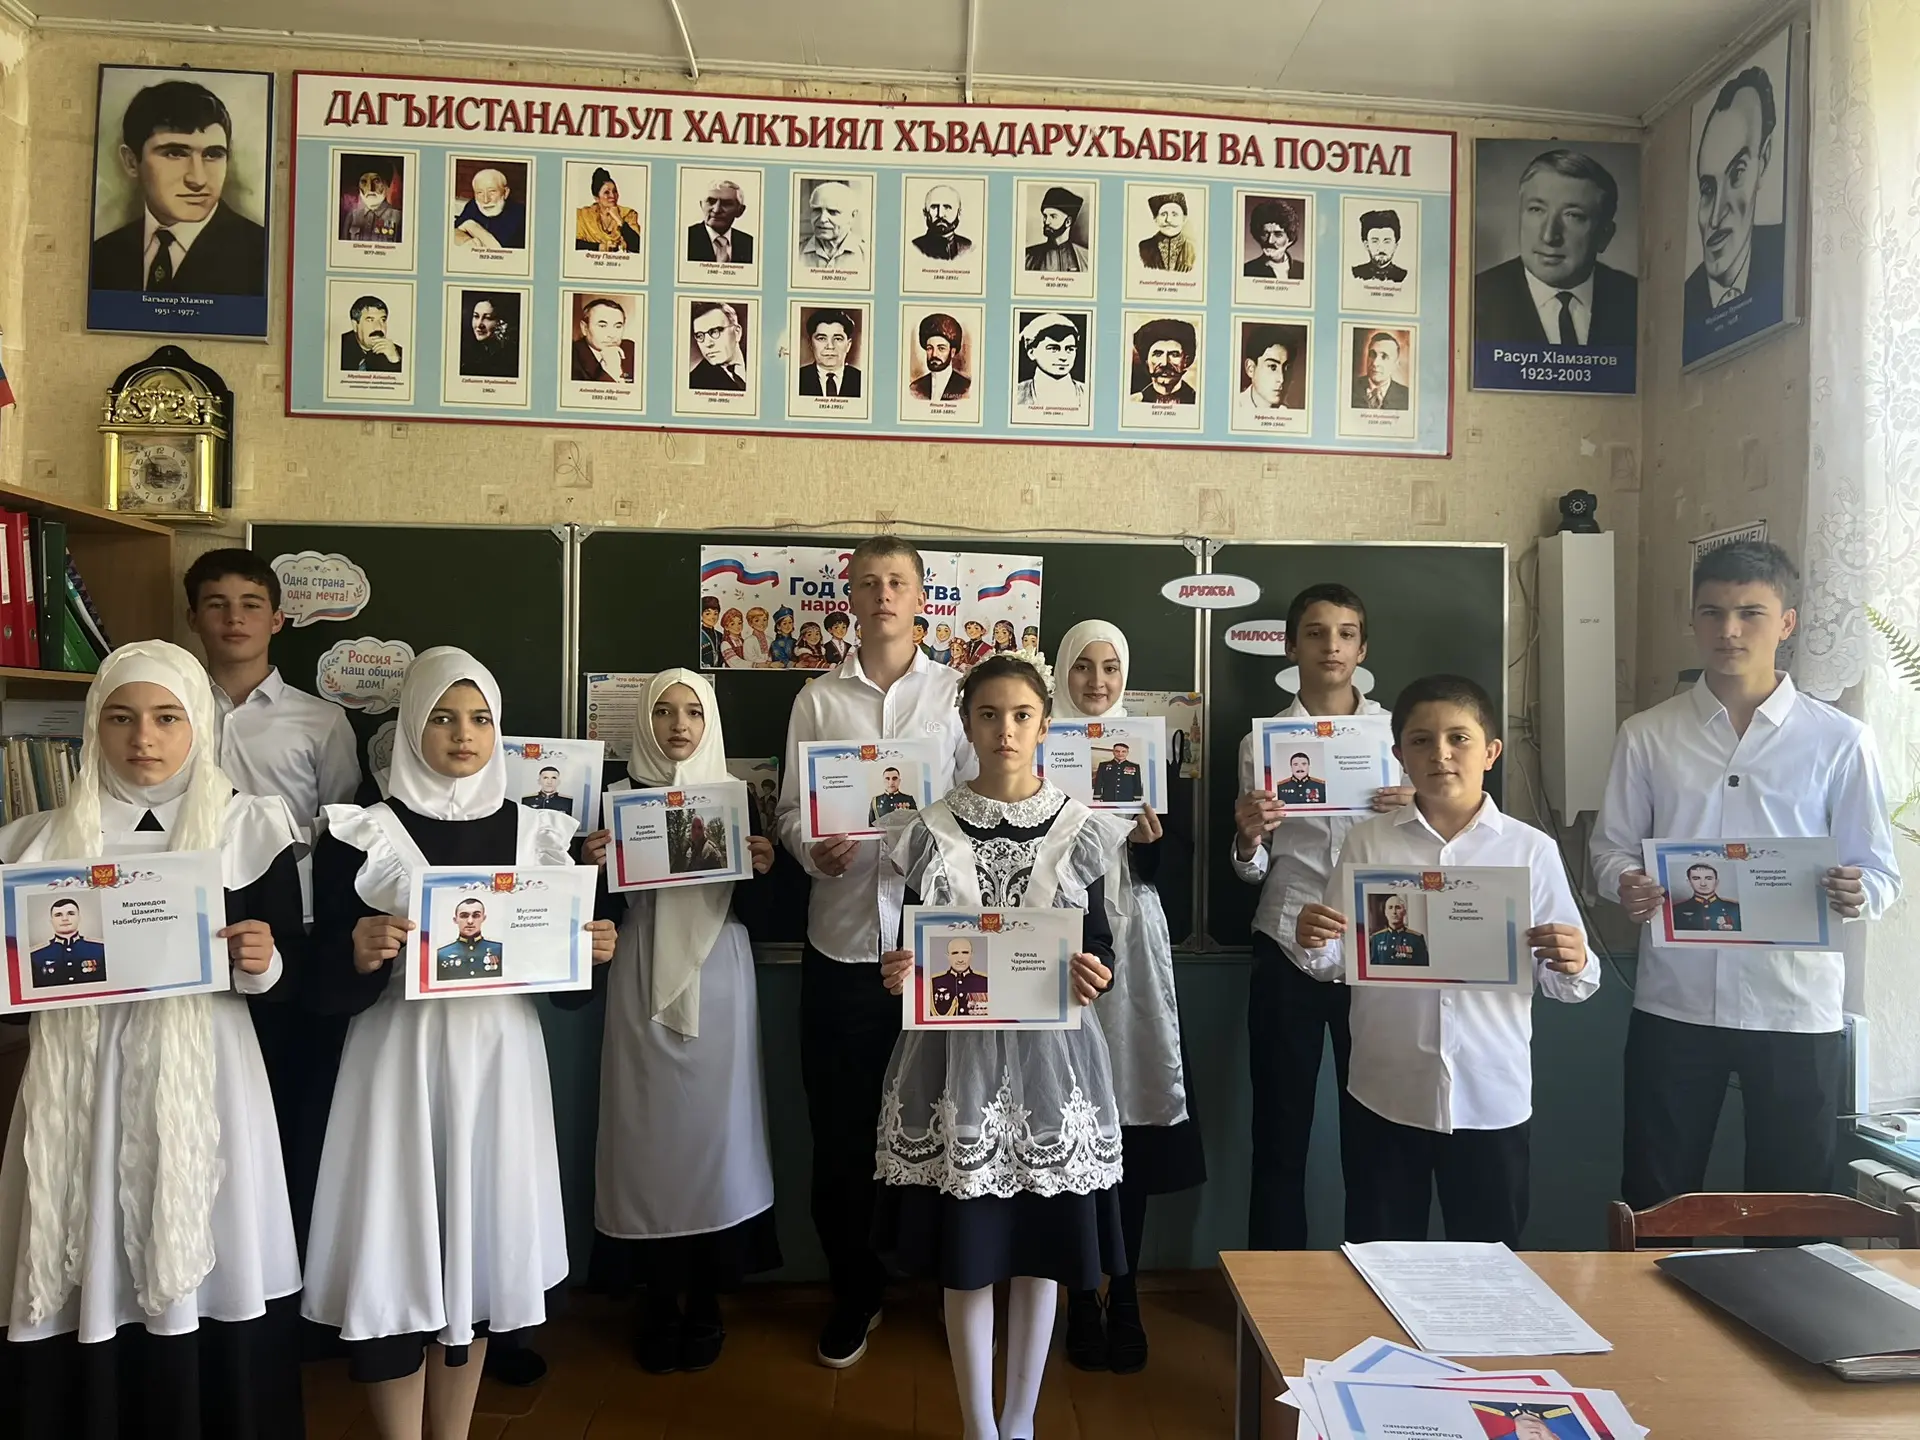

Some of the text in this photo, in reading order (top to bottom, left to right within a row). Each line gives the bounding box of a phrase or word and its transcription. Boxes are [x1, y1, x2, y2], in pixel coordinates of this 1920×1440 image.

[324, 89, 1412, 177] ДАГЪИСТАНАЛЪУЛ ХАЛКЪИЯЛ ХЪВАДАРУХЪАБИ ВА ПОЭТАЛ
[154, 308, 170, 316] 1951
[178, 308, 195, 317] 1977
[1493, 349, 1538, 366] Расул
[1520, 367, 1592, 382] 1923-2003
[157, 495, 164, 503] 6
[282, 572, 308, 586] Одна
[789, 577, 835, 599] Год
[1179, 585, 1236, 598] ДРУЖБА
[287, 589, 349, 602] одна мечта!
[1230, 629, 1286, 642] МИЛОСЕ
[348, 649, 391, 666] Россия
[341, 665, 404, 679] наш общий
[356, 679, 385, 690] дом!
[122, 898, 166, 909] Магомедов
[131, 907, 165, 916] Шамиль
[516, 907, 548, 915] Муслимов
[112, 914, 178, 926] Набибуллагович
[517, 914, 542, 922] Муслим
[1382, 1423, 1439, 1431] Абраменко
[1383, 1430, 1463, 1439] Владимирович
